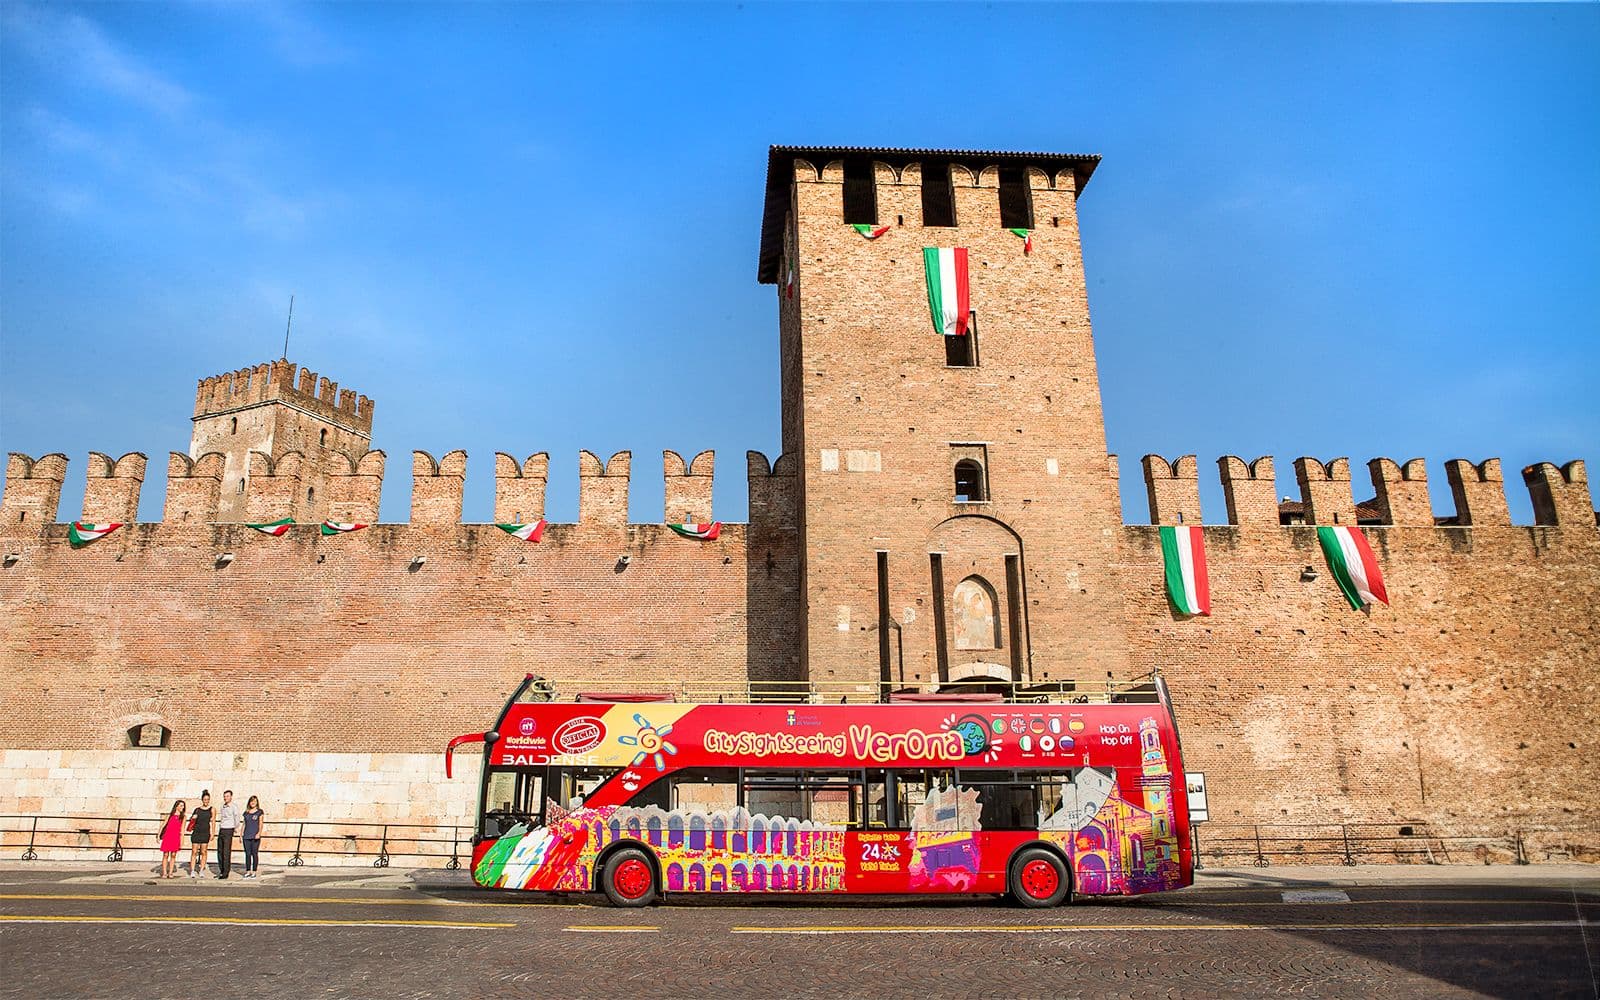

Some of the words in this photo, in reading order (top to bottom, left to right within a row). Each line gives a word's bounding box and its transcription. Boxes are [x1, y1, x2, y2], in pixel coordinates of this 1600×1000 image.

[1100, 725, 1117, 734] Hop
[1118, 724, 1130, 734] On
[561, 727, 599, 746] OFFICIAL
[1101, 736, 1118, 746] Hop
[1120, 735, 1133, 745] Off
[502, 754, 600, 766] BALDENSE
[862, 843, 880, 861] 24
